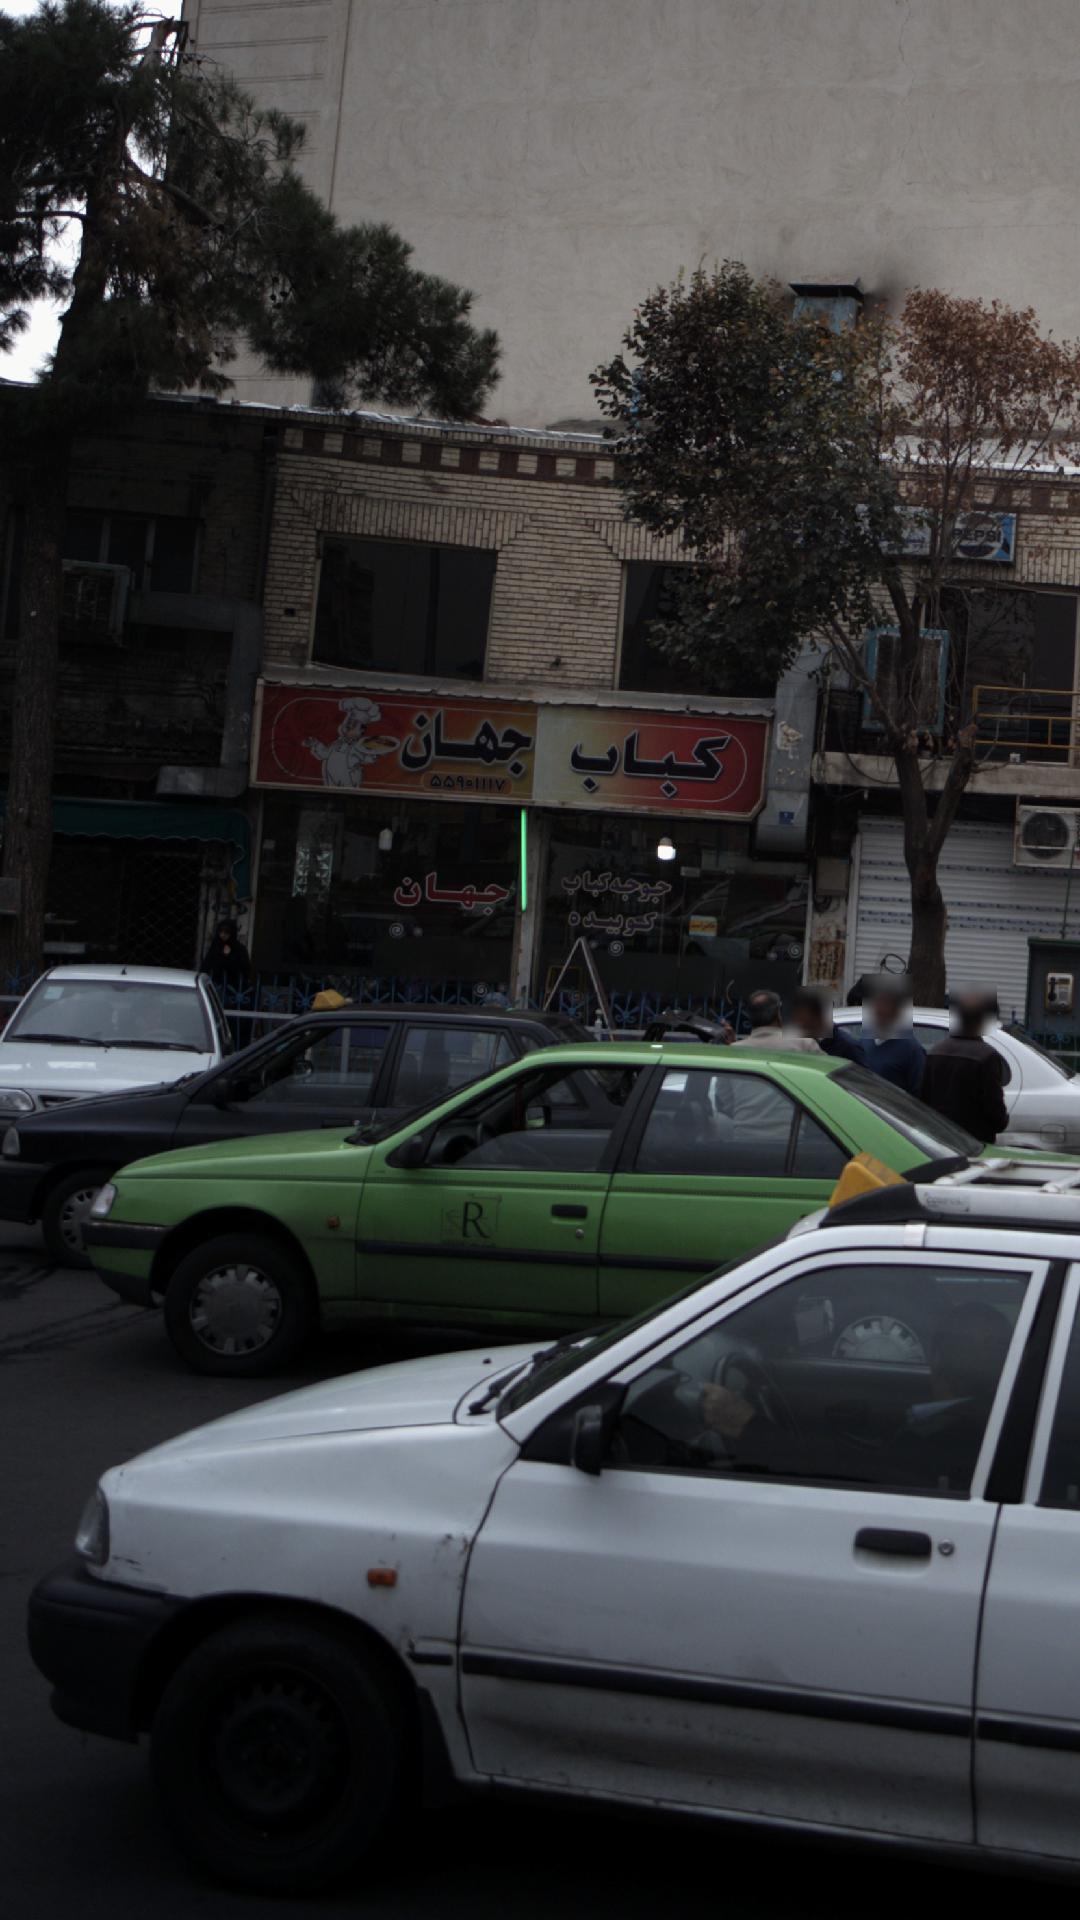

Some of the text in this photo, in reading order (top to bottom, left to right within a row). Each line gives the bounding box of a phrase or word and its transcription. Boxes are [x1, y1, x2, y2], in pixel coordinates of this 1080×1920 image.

[952, 527, 1001, 543] PEPSI
[401, 707, 732, 798] کباب جهان
[393, 871, 510, 916] جهان
[561, 870, 673, 904] جوجه کباب
[567, 910, 658, 936] کوبیده
